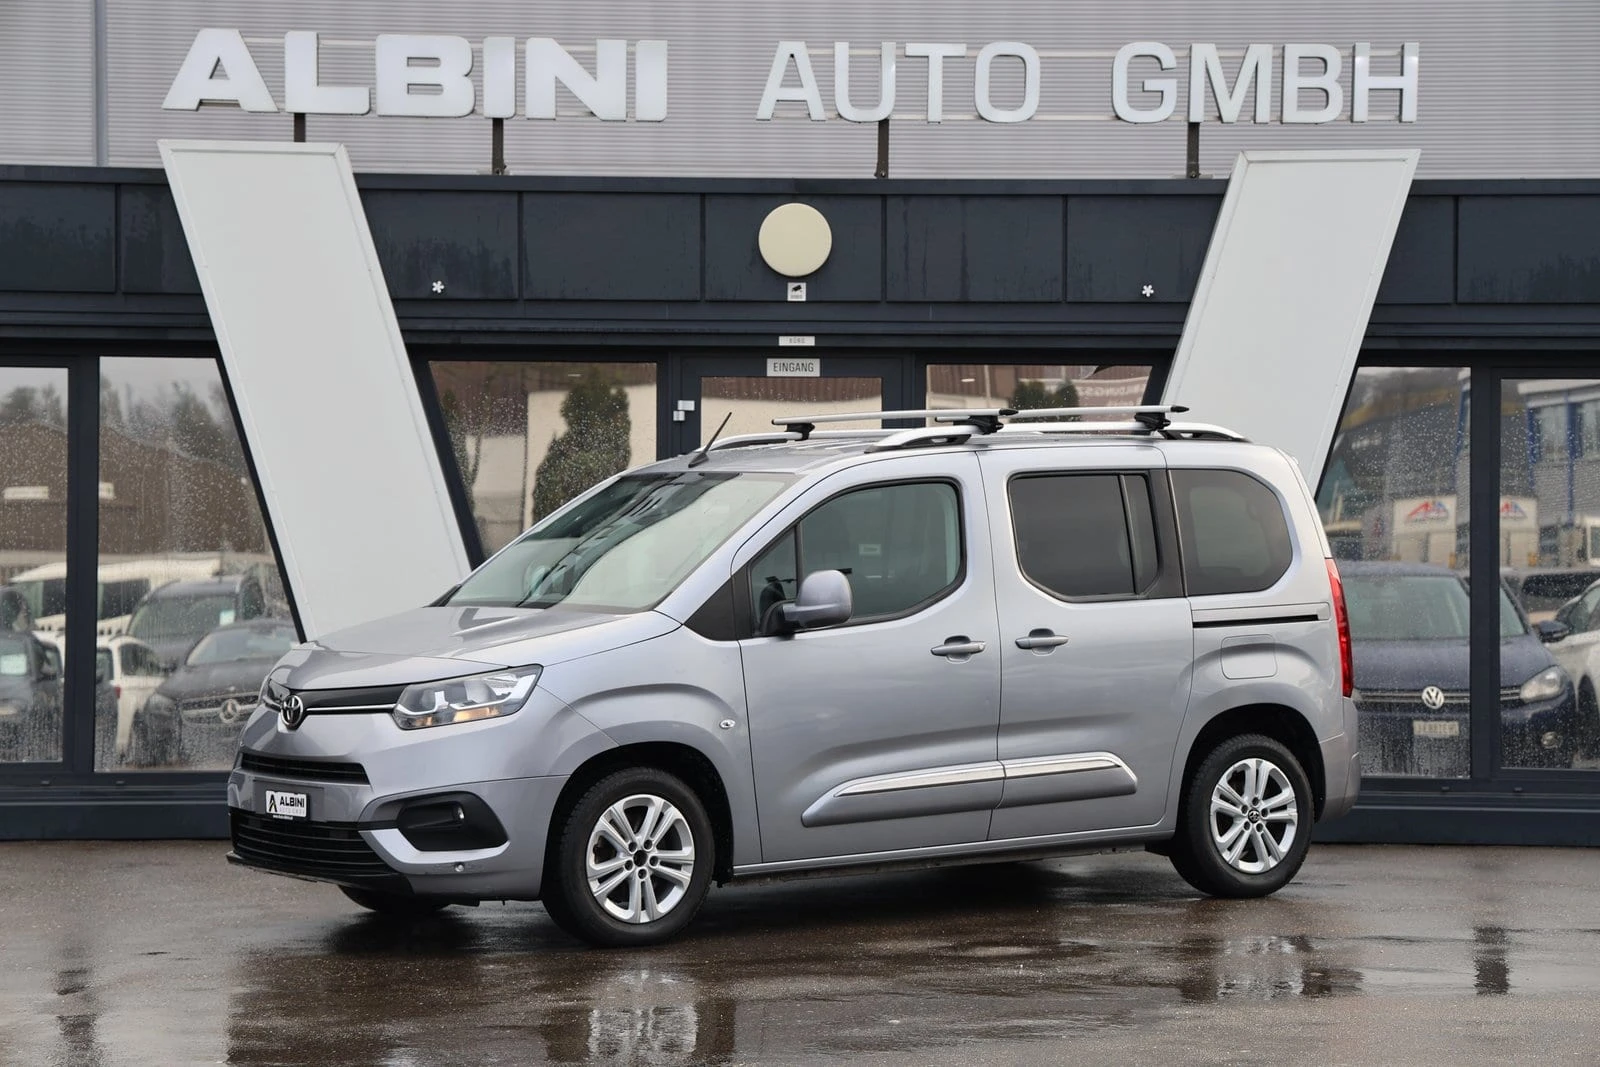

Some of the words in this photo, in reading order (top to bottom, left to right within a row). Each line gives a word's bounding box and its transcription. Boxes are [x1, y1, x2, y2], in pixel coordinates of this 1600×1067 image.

[162, 28, 668, 122] ALBINI
[755, 41, 1041, 124] AUTO
[1111, 41, 1420, 124] GMBH
[773, 362, 814, 372] EINGANG
[280, 796, 305, 808] ALBINI
